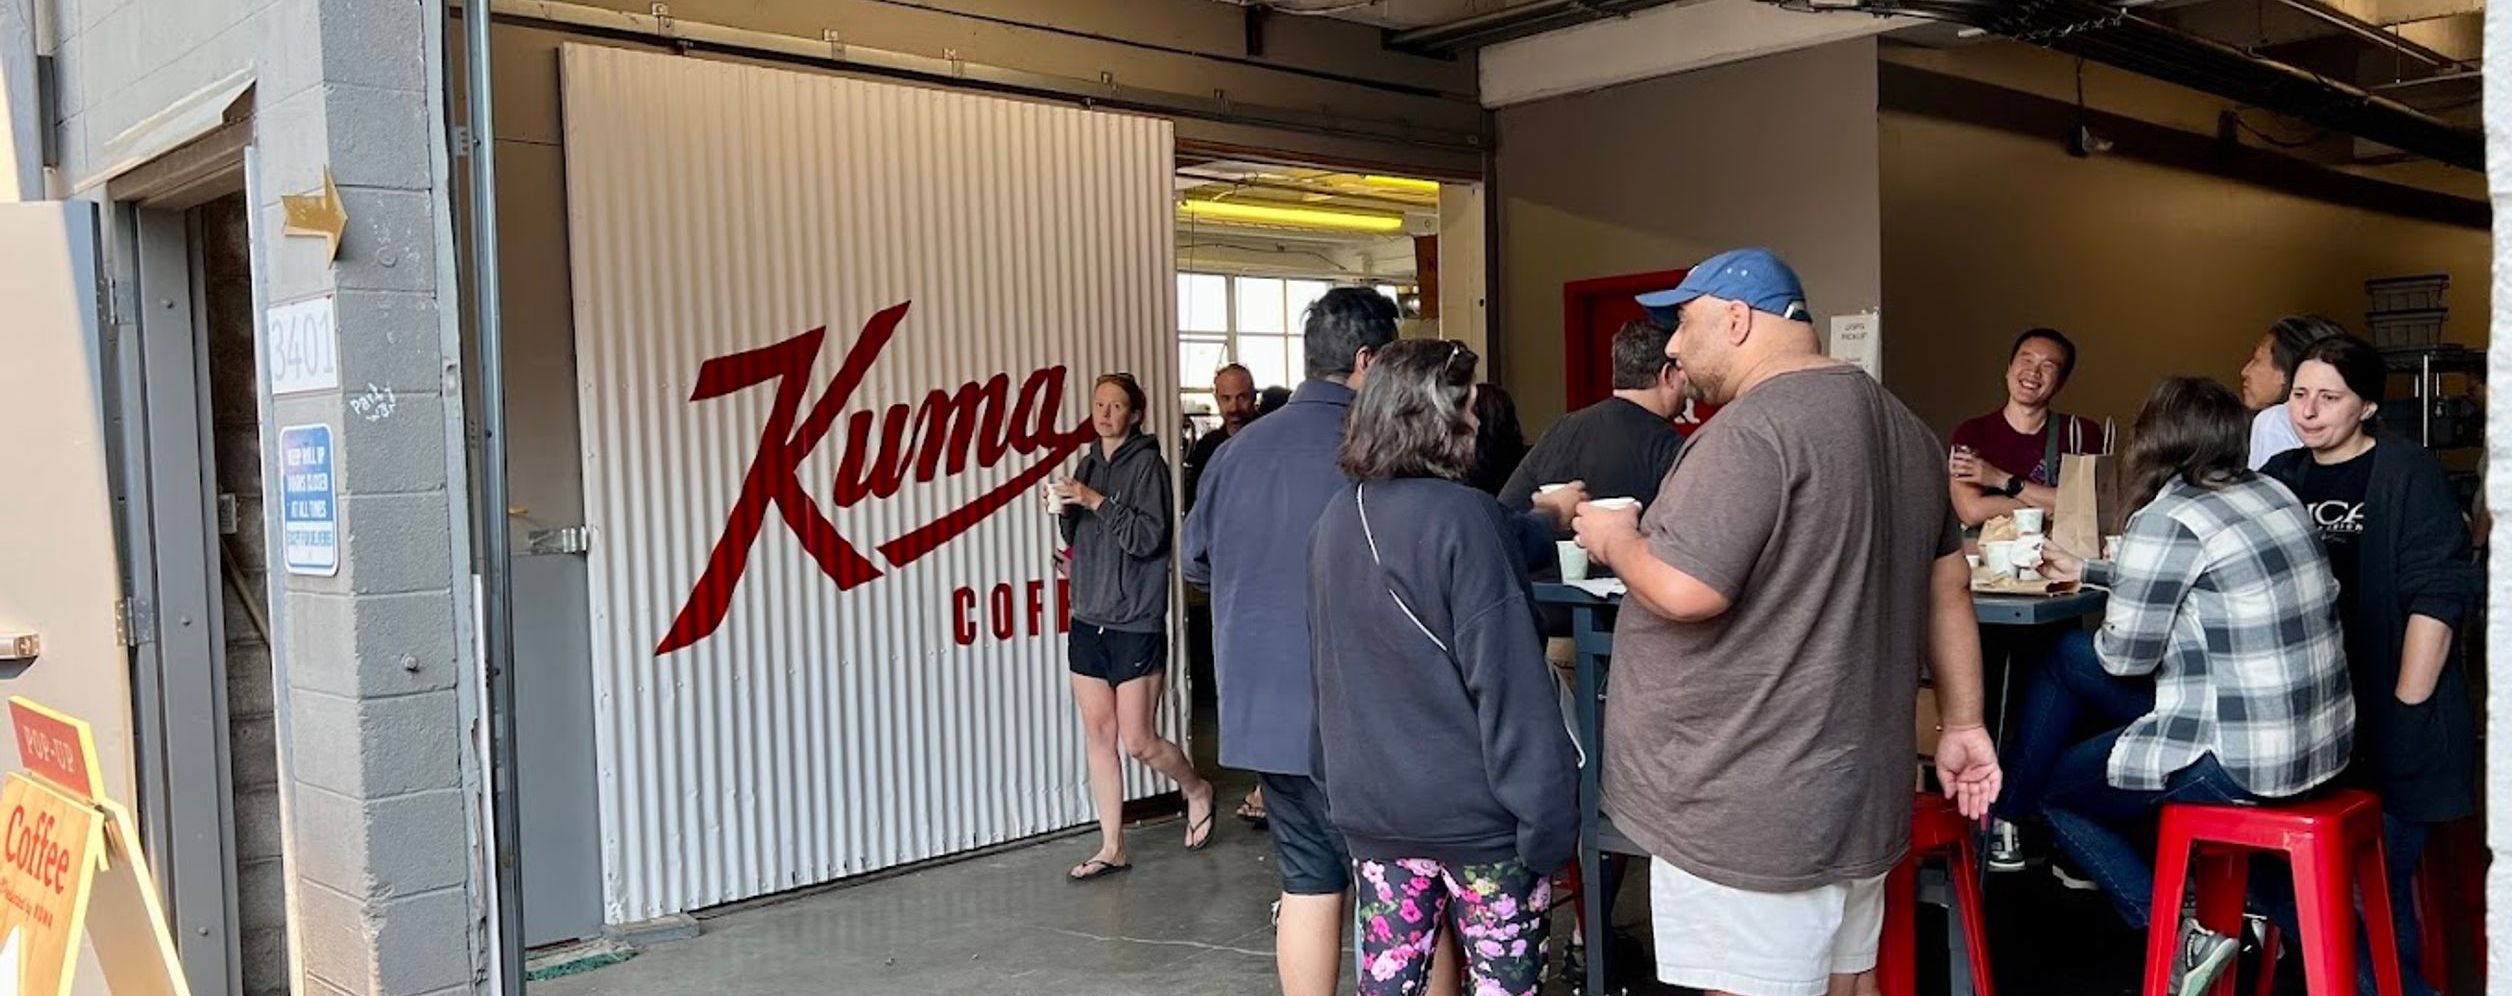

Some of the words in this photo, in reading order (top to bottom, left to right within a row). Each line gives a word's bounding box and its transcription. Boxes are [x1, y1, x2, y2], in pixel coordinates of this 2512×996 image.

[272, 310, 334, 381] 3401
[655, 300, 1098, 656] Kuma
[953, 578, 1072, 645] COFF
[23, 724, 75, 773] POP-UP
[5, 804, 70, 895] Coffee
